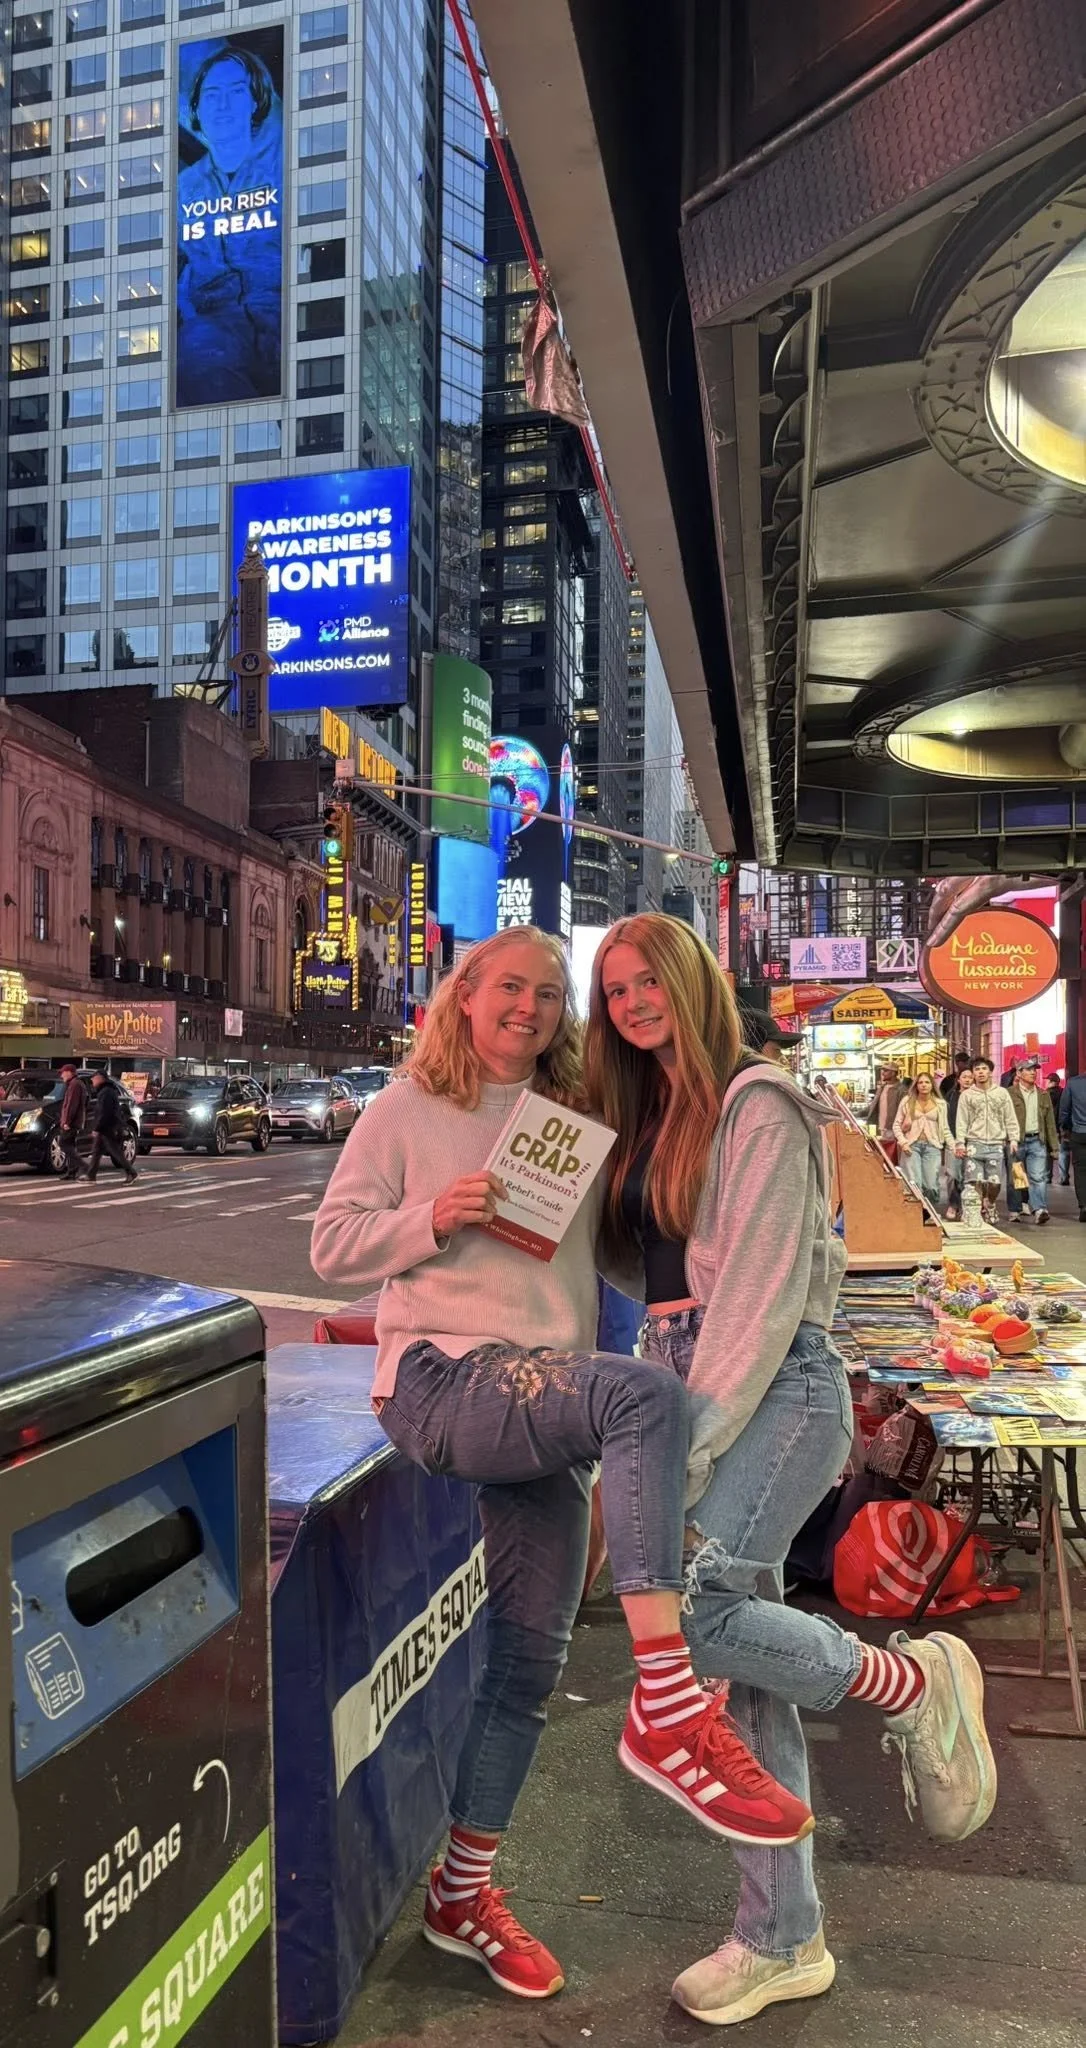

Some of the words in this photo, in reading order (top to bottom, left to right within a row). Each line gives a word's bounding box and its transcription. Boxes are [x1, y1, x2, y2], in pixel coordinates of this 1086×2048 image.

[182, 197, 233, 218] YOUR
[237, 188, 278, 210] RISK
[183, 221, 206, 241] IS
[214, 210, 277, 236] REAL
[248, 507, 393, 537] PARKINSON'S
[343, 616, 372, 628] PMD
[271, 653, 390, 675] ARKINSONS.COM
[246, 689, 256, 729] LYRIC
[463, 687, 470, 704] 3
[323, 706, 350, 760] NEW
[359, 737, 397, 800] ICTORY
[411, 863, 425, 925] VICTORY
[328, 895, 344, 932] NEW
[497, 906, 532, 916] ENCES
[410, 933, 424, 964] NEW
[951, 932, 1039, 957] Madame
[950, 955, 1037, 978] Tussauds
[964, 981, 991, 990] NEW
[993, 981, 1024, 990] YORK
[83, 1012, 122, 1039] Harry
[123, 1009, 163, 1040] Potter
[837, 1008, 891, 1018] SABRETT
[541, 1117, 582, 1151] OH
[500, 1156, 515, 1171] It's
[518, 1165, 579, 1200] Parkinson's
[505, 1180, 535, 1200] Rebel's
[537, 1195, 563, 1213] Guide
[370, 1611, 435, 1737] TIMES
[440, 1549, 487, 1645] SQUA
[84, 1853, 110, 1899] GO
[114, 1825, 139, 1869] TO
[84, 1822, 181, 1946] TSQ.ORG
[141, 1862, 264, 2048] SQUARE
